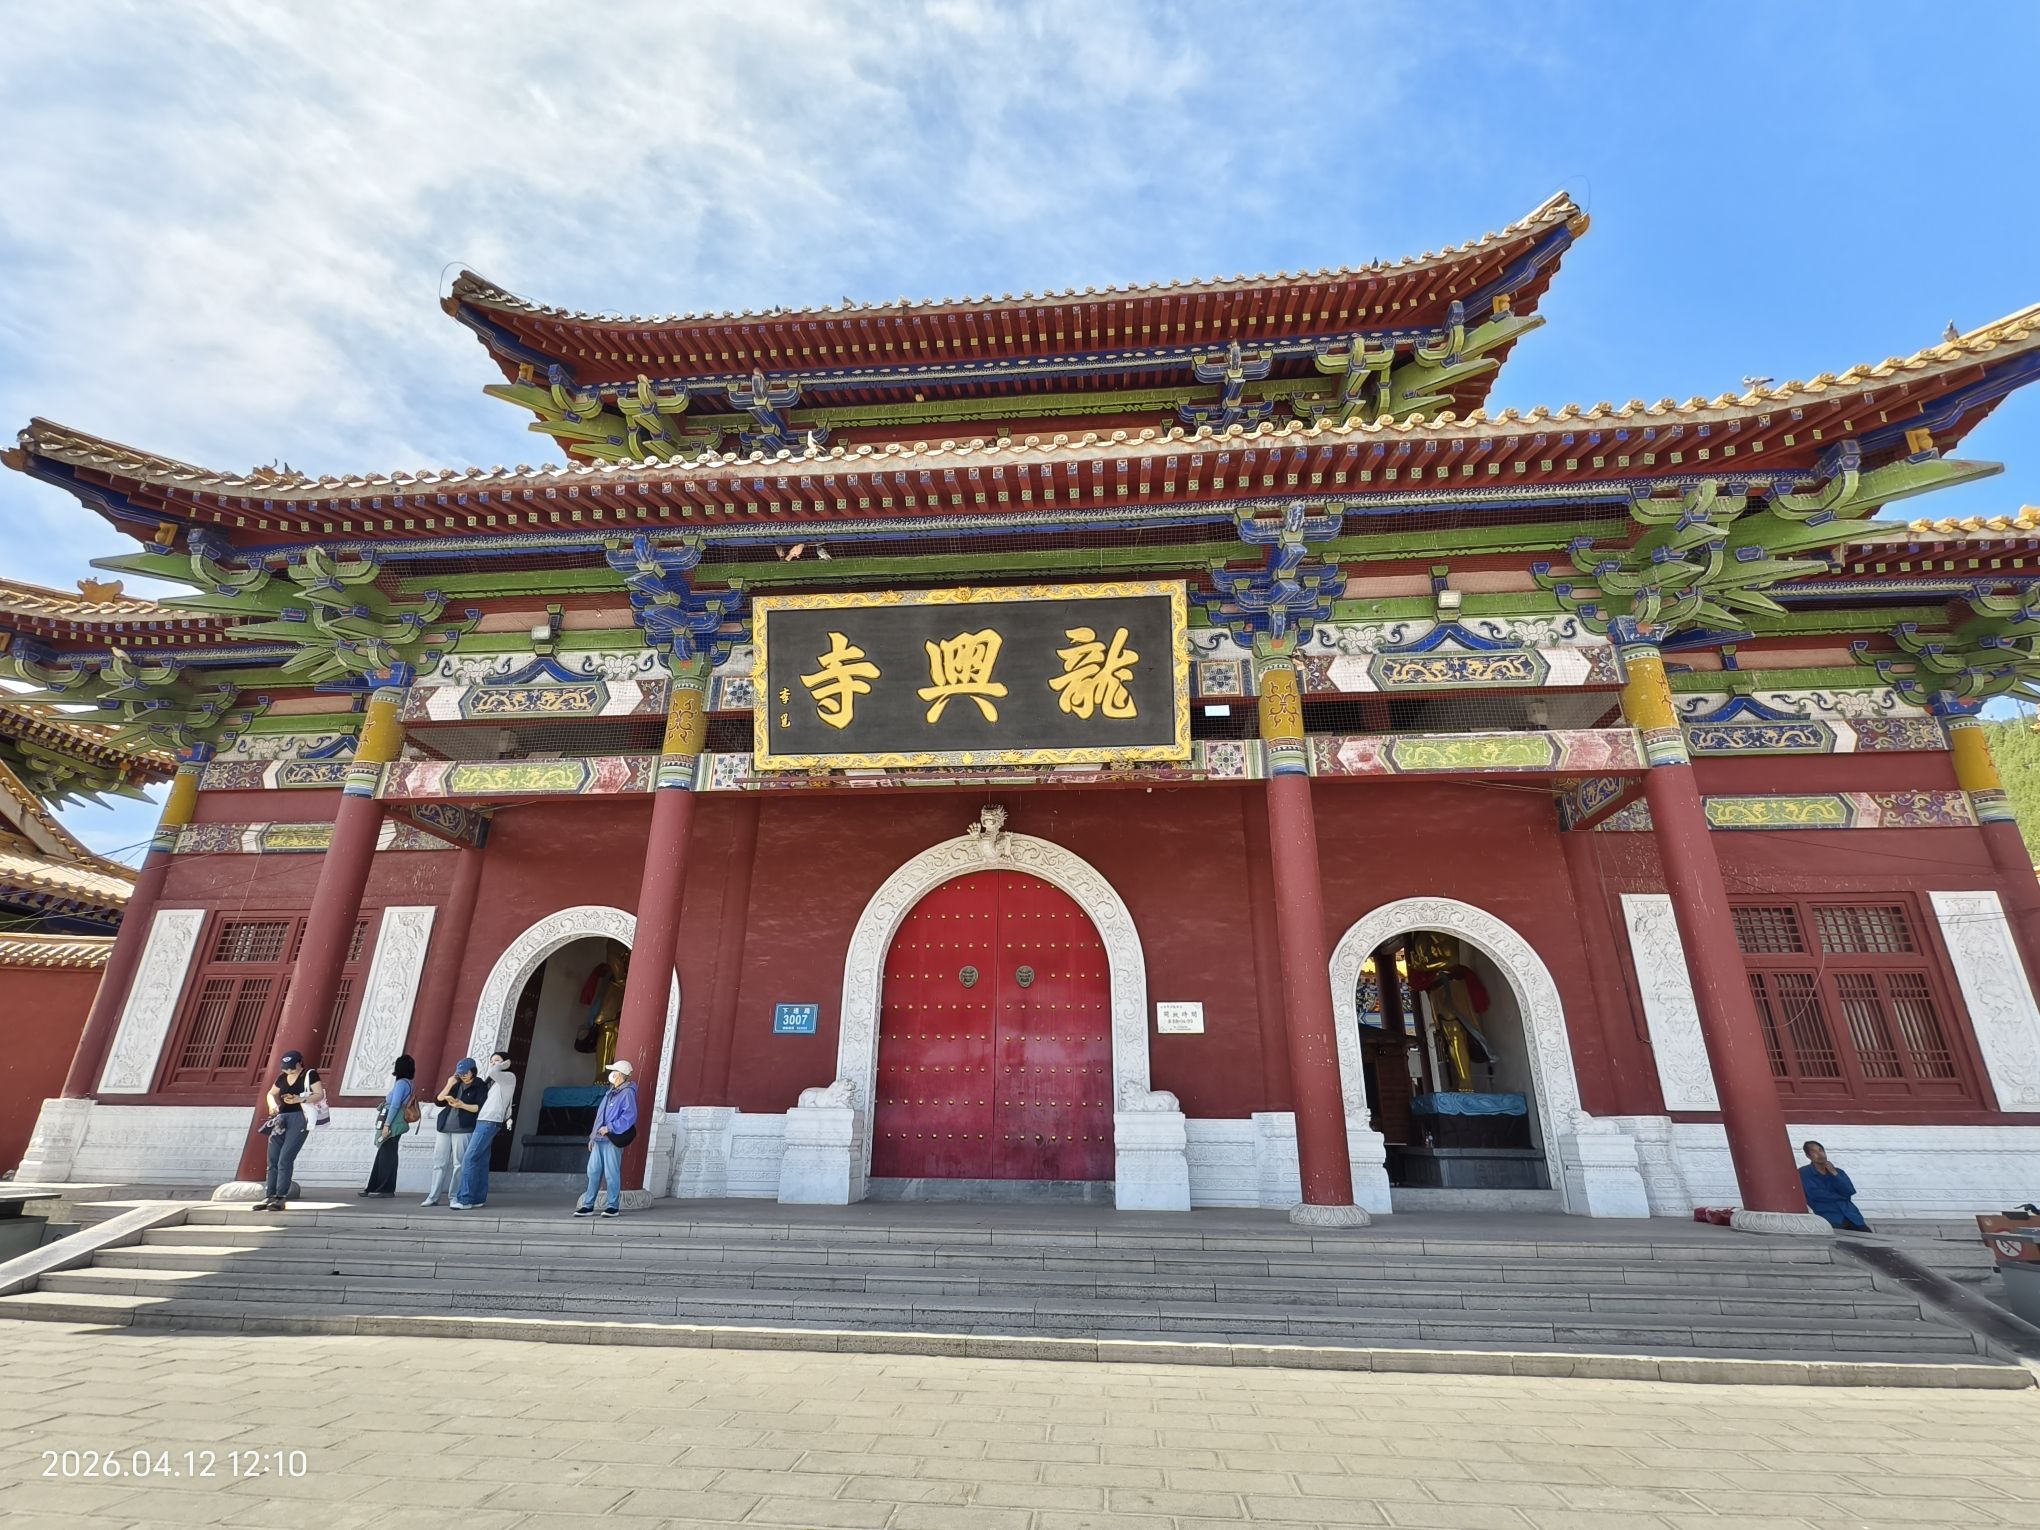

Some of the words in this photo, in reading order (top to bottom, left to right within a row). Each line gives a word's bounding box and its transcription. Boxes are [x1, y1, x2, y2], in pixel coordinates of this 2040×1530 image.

[799, 626, 1142, 730] 龍興寺
[783, 1015, 808, 1025] 3007
